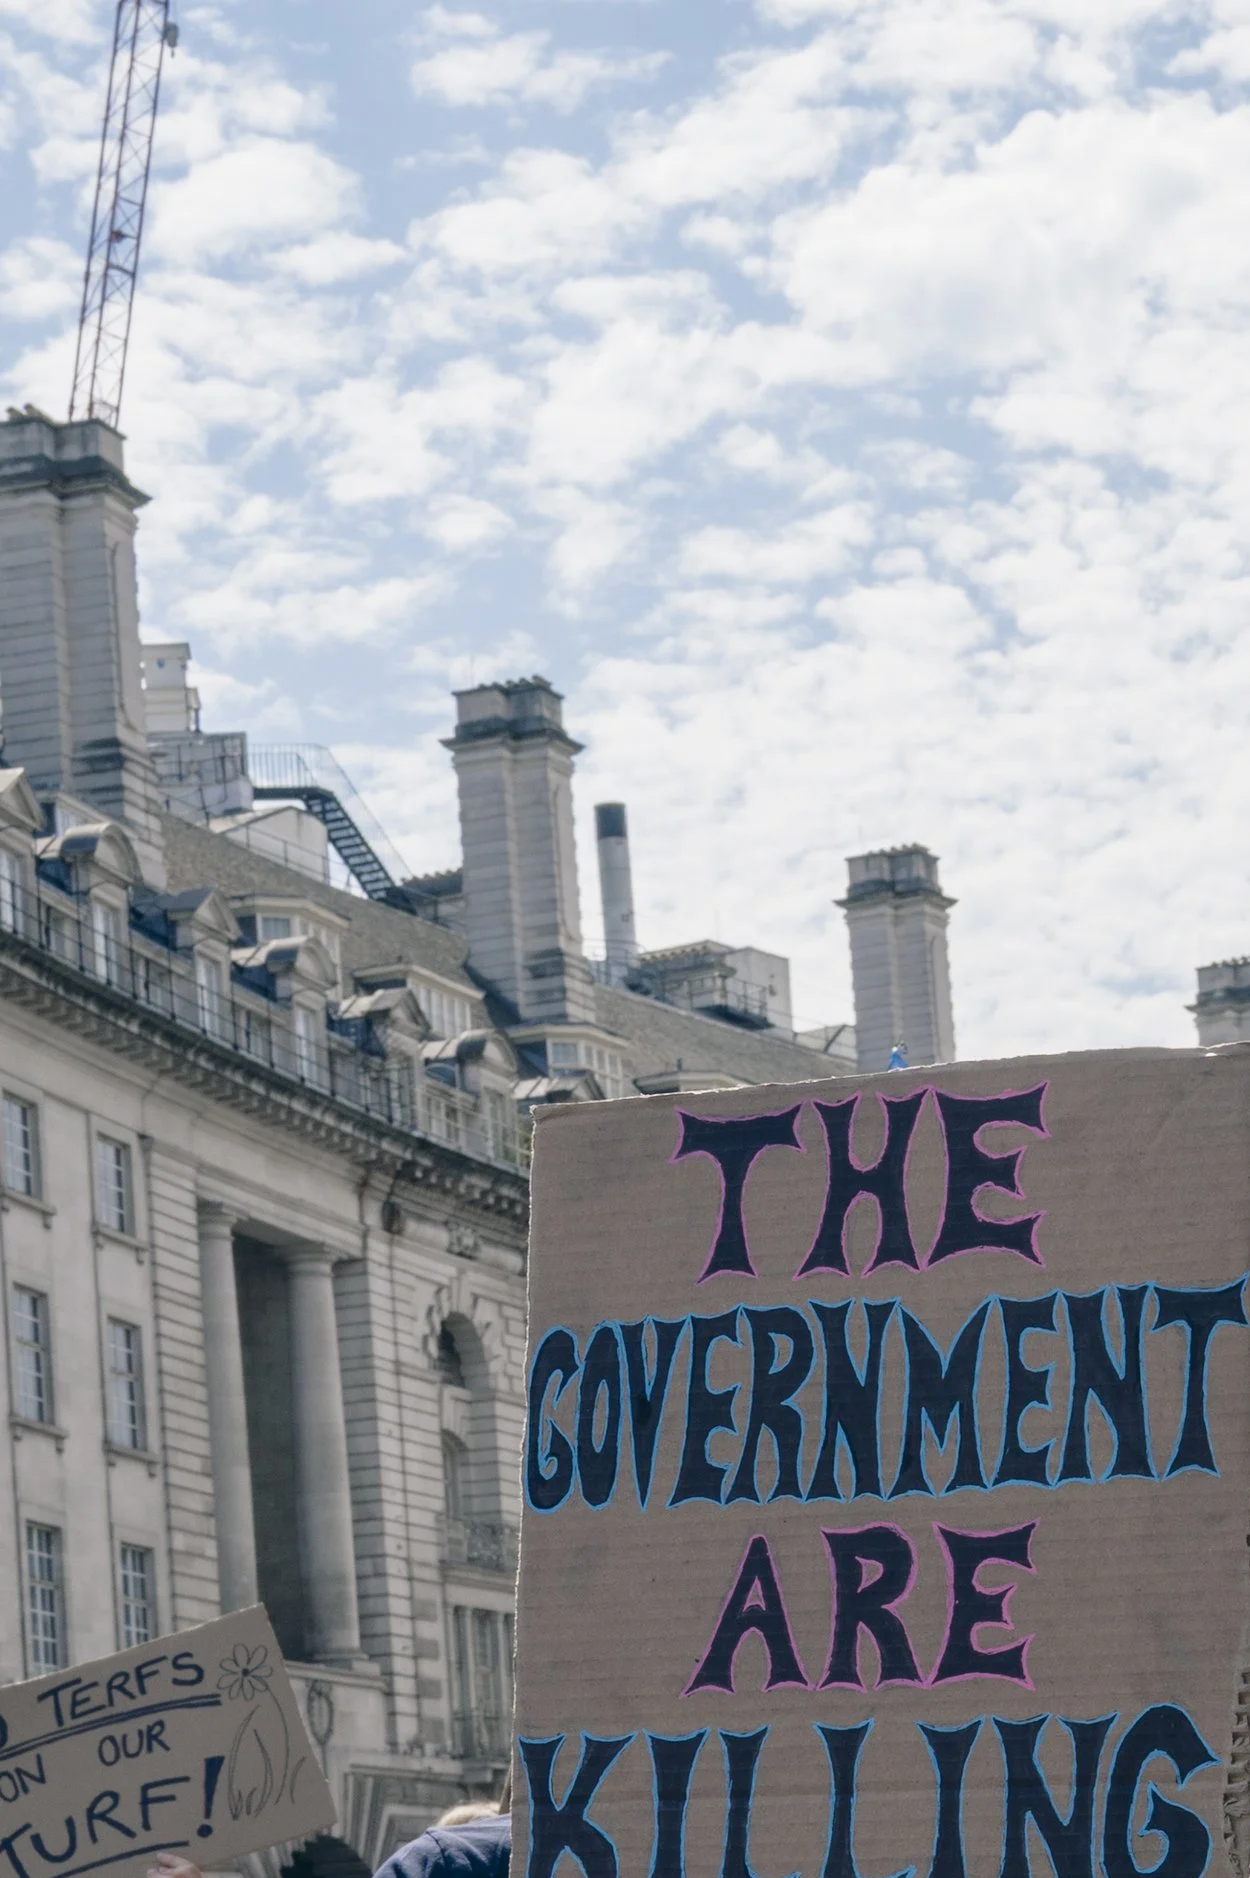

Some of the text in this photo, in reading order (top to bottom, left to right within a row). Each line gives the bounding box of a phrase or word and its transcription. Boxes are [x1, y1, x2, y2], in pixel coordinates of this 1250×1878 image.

[669, 1081, 1050, 1284] THE
[523, 1272, 1250, 1514] GOVERNMENT
[37, 1651, 205, 1728] TERFS
[680, 1519, 1041, 1698] ARE
[0, 1719, 171, 1803] ON OUR
